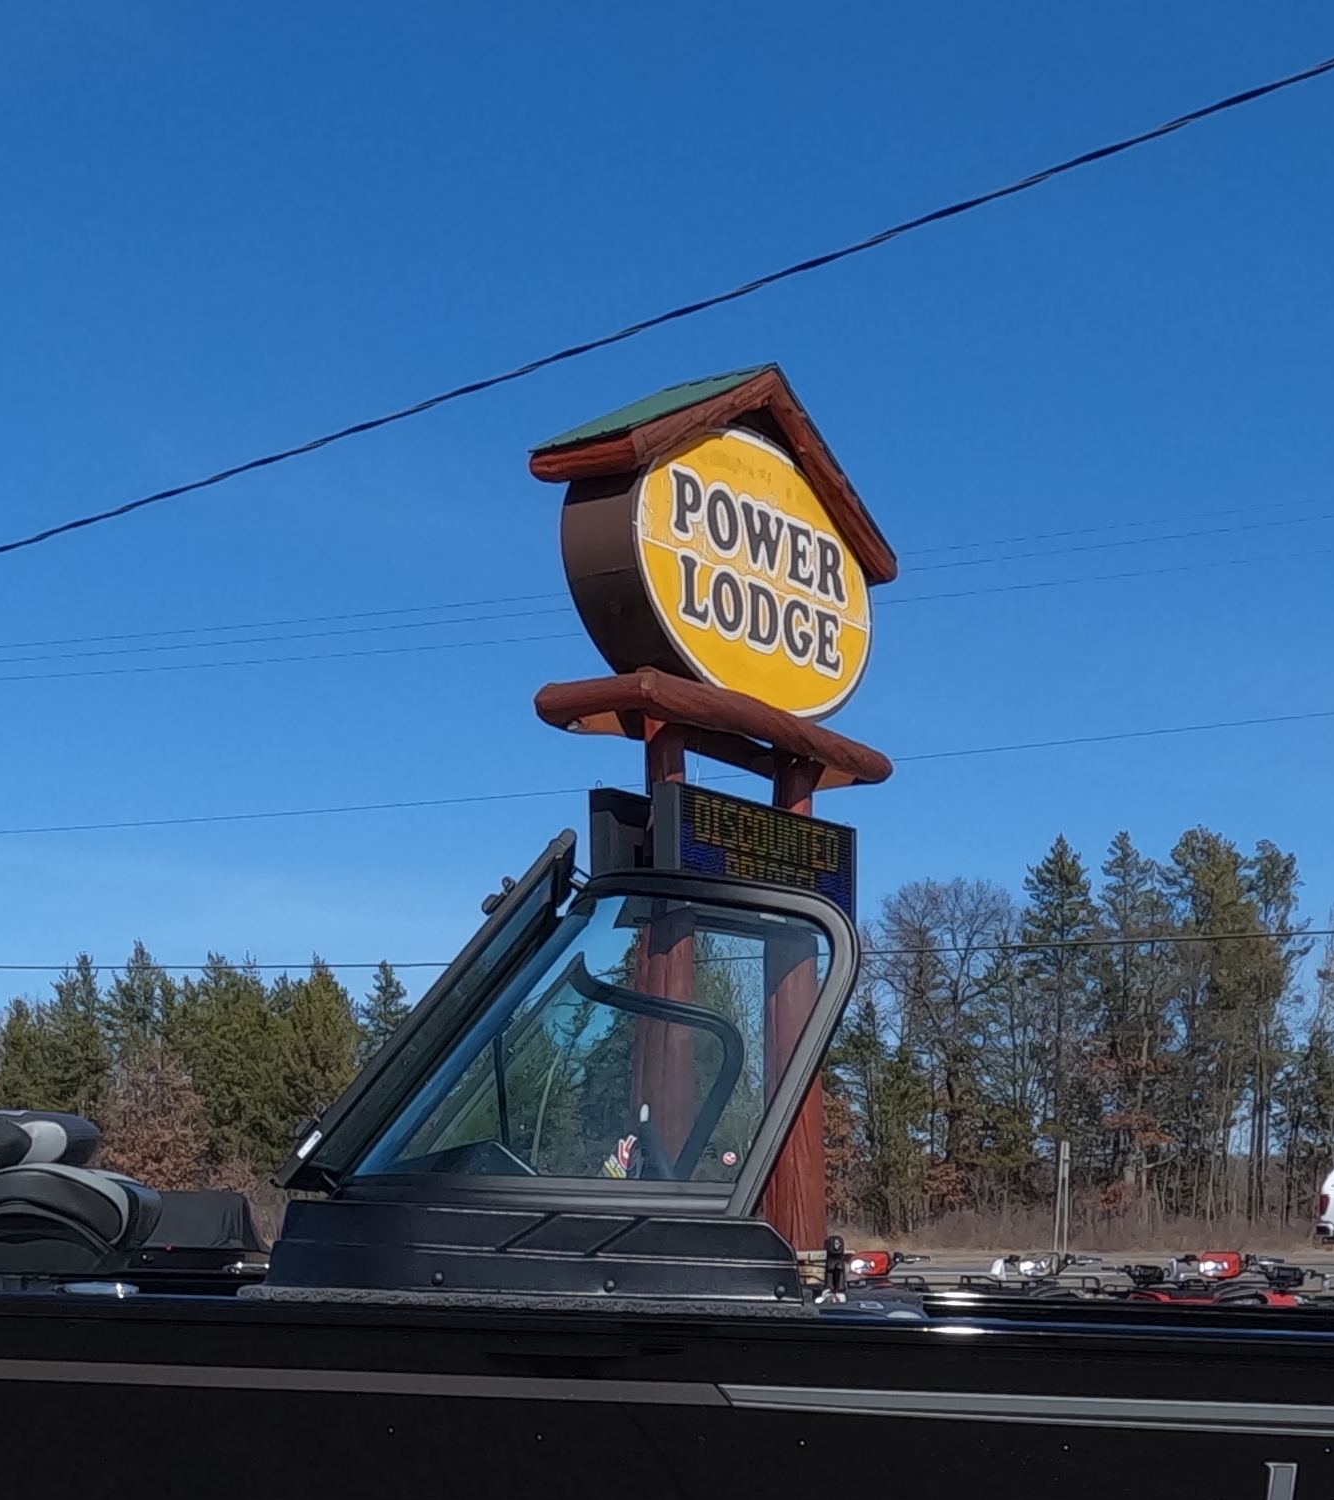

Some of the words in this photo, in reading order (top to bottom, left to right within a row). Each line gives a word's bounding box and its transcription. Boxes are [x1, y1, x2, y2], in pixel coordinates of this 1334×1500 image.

[672, 468, 846, 603] POWER
[680, 553, 842, 673] LODGE
[694, 794, 839, 873] DISCOUNTED
